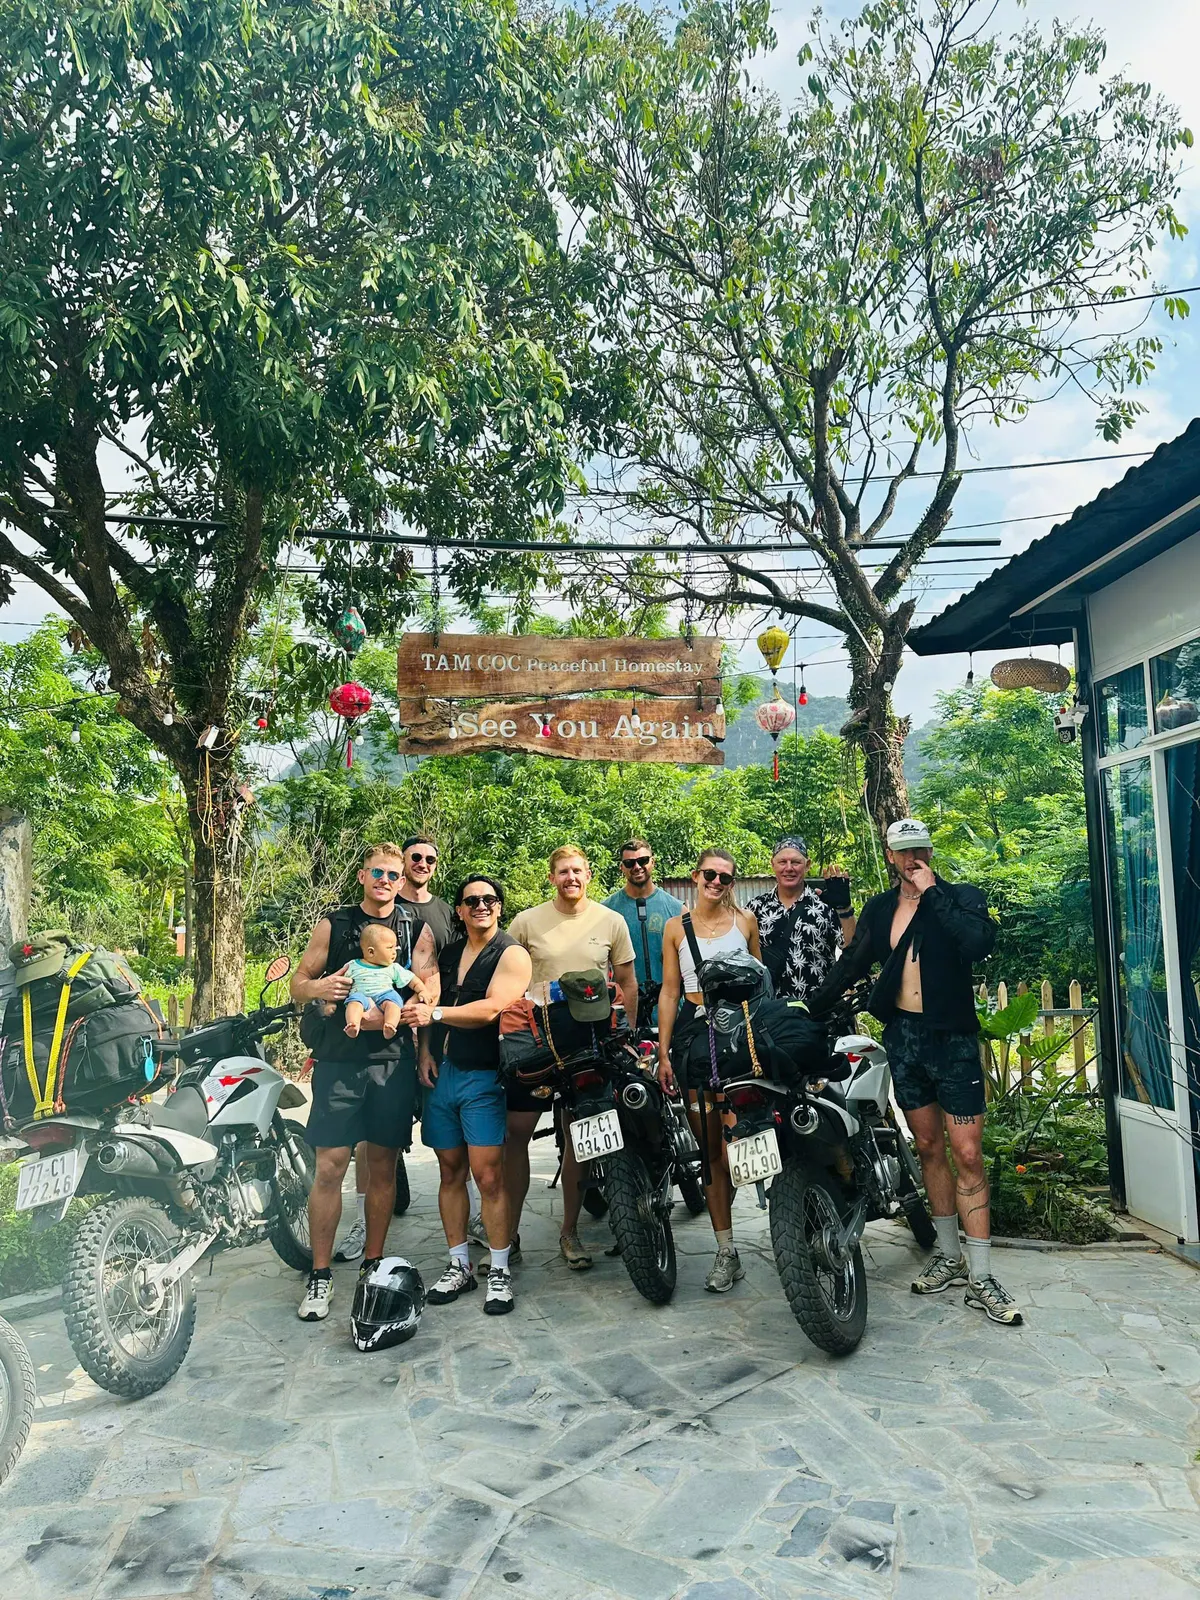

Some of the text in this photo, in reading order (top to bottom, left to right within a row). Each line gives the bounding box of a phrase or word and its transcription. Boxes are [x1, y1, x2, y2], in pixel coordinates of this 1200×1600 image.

[421, 653, 703, 675] TAM COC Peaceful Homestay
[457, 712, 714, 746] See You Again
[953, 1115, 976, 1125] 1994
[577, 1131, 619, 1158] 934.01
[29, 1156, 66, 1185] 77-C1
[733, 1153, 778, 1182] 934.90
[20, 1175, 71, 1207] 722.46
